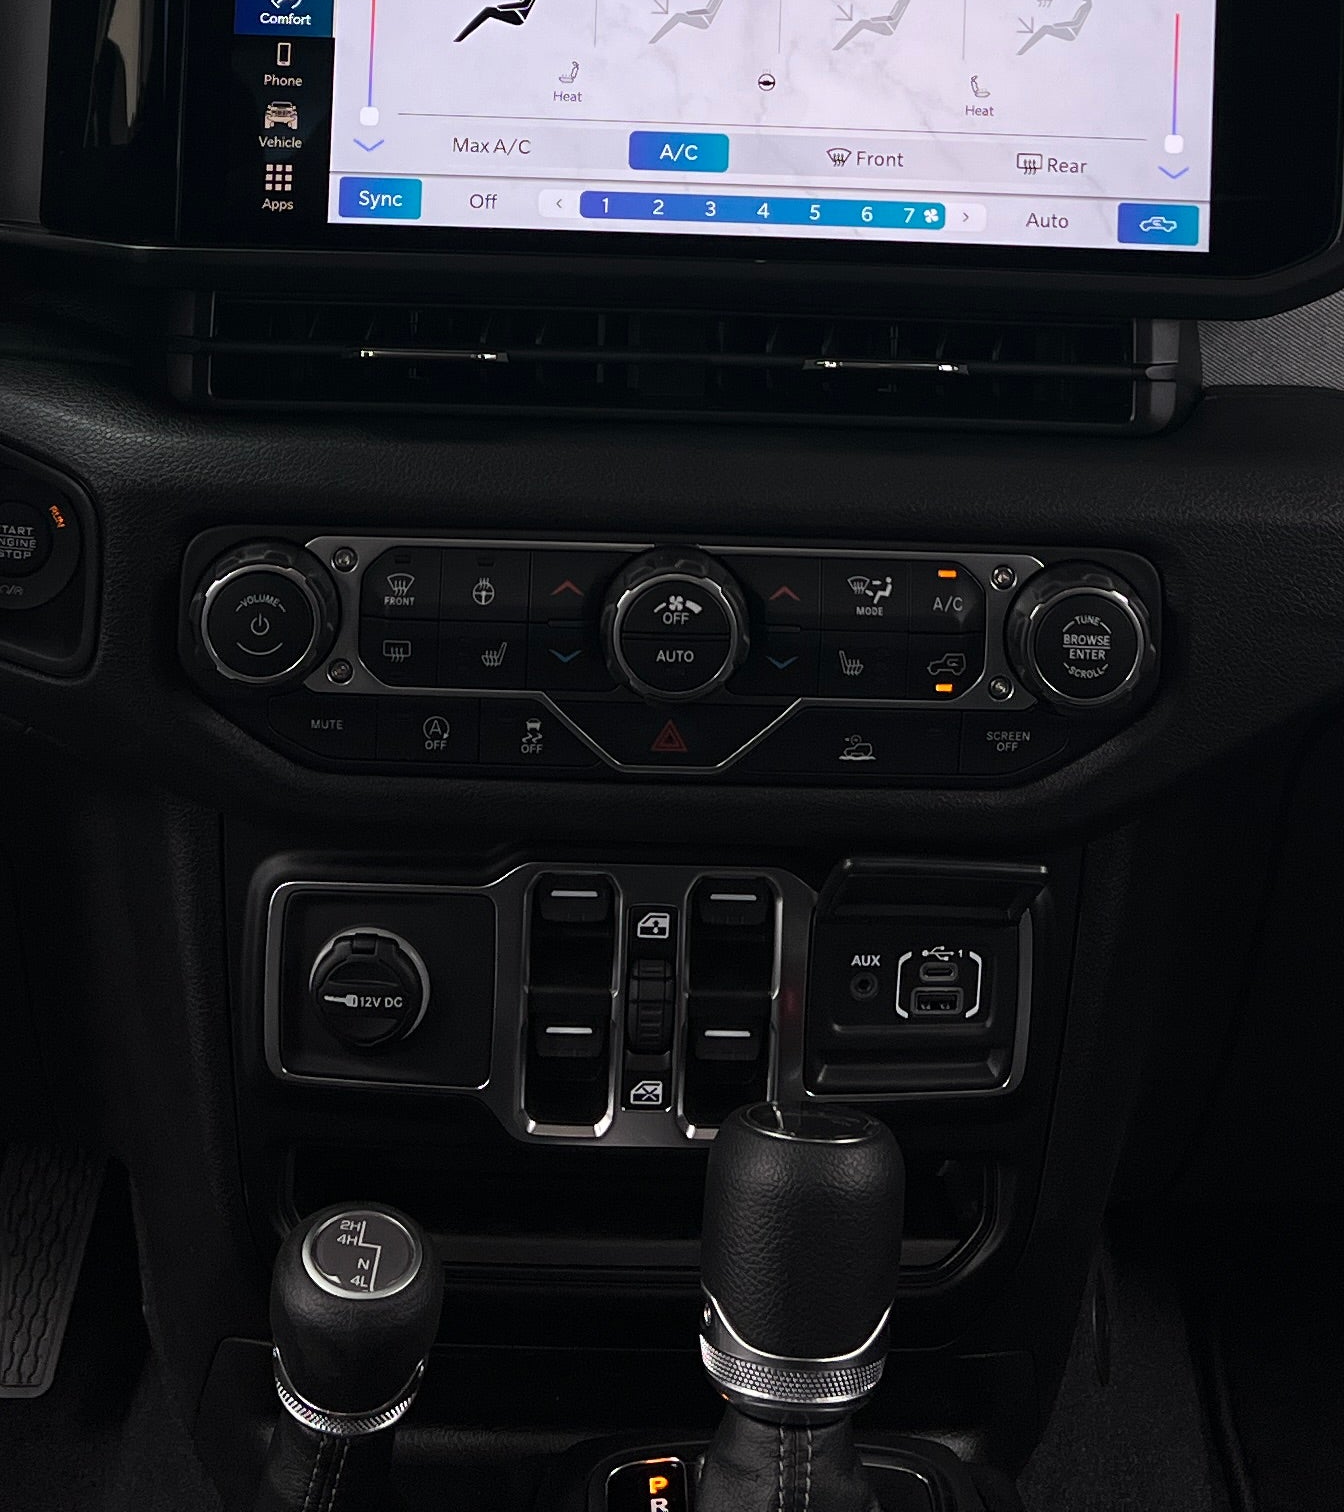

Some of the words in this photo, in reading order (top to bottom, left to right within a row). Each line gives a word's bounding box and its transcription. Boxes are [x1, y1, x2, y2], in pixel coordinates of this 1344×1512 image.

[260, 13, 311, 25] Comfort
[264, 73, 302, 88] Phone
[553, 91, 582, 103] Heat
[965, 104, 994, 116] Heat
[259, 136, 302, 149] Vehicle
[453, 137, 490, 154] Max
[494, 137, 531, 156] A/C
[659, 143, 698, 161] A/C
[857, 150, 904, 168] Front
[1048, 157, 1087, 174] Rear
[262, 198, 293, 213] Apps
[359, 190, 403, 209] Sync
[470, 193, 497, 210] Off
[602, 199, 609, 214] 1
[652, 200, 664, 215] 2
[705, 201, 716, 216] 3
[757, 202, 770, 217] 4
[809, 205, 821, 220] 5
[861, 207, 873, 222] 6
[903, 208, 915, 223] 7
[1026, 212, 1069, 229] Auto
[49, 505, 65, 528] RUN
[240, 594, 280, 608] VOLUME
[384, 596, 414, 606] FRONT
[933, 597, 962, 612] A/C
[856, 607, 883, 616] MODE
[663, 612, 689, 625] OFF
[1074, 615, 1100, 627] TUNE
[1063, 634, 1110, 646] BROWSE
[656, 649, 694, 663] AUTO
[1069, 648, 1105, 660] ENTER
[1068, 665, 1104, 679] SCROLL
[311, 720, 343, 729] MUTE
[986, 731, 1030, 741] SCREEN
[425, 740, 447, 750] OFF
[521, 743, 543, 754] OFF
[996, 741, 1018, 752] OFF
[852, 954, 880, 968] AUX
[359, 996, 382, 1008] 12V
[385, 996, 403, 1008] DC
[340, 1220, 360, 1232] 2H
[337, 1234, 358, 1246] 4H
[358, 1259, 369, 1269] N
[350, 1275, 368, 1287] 4L
[649, 1476, 668, 1494] P
